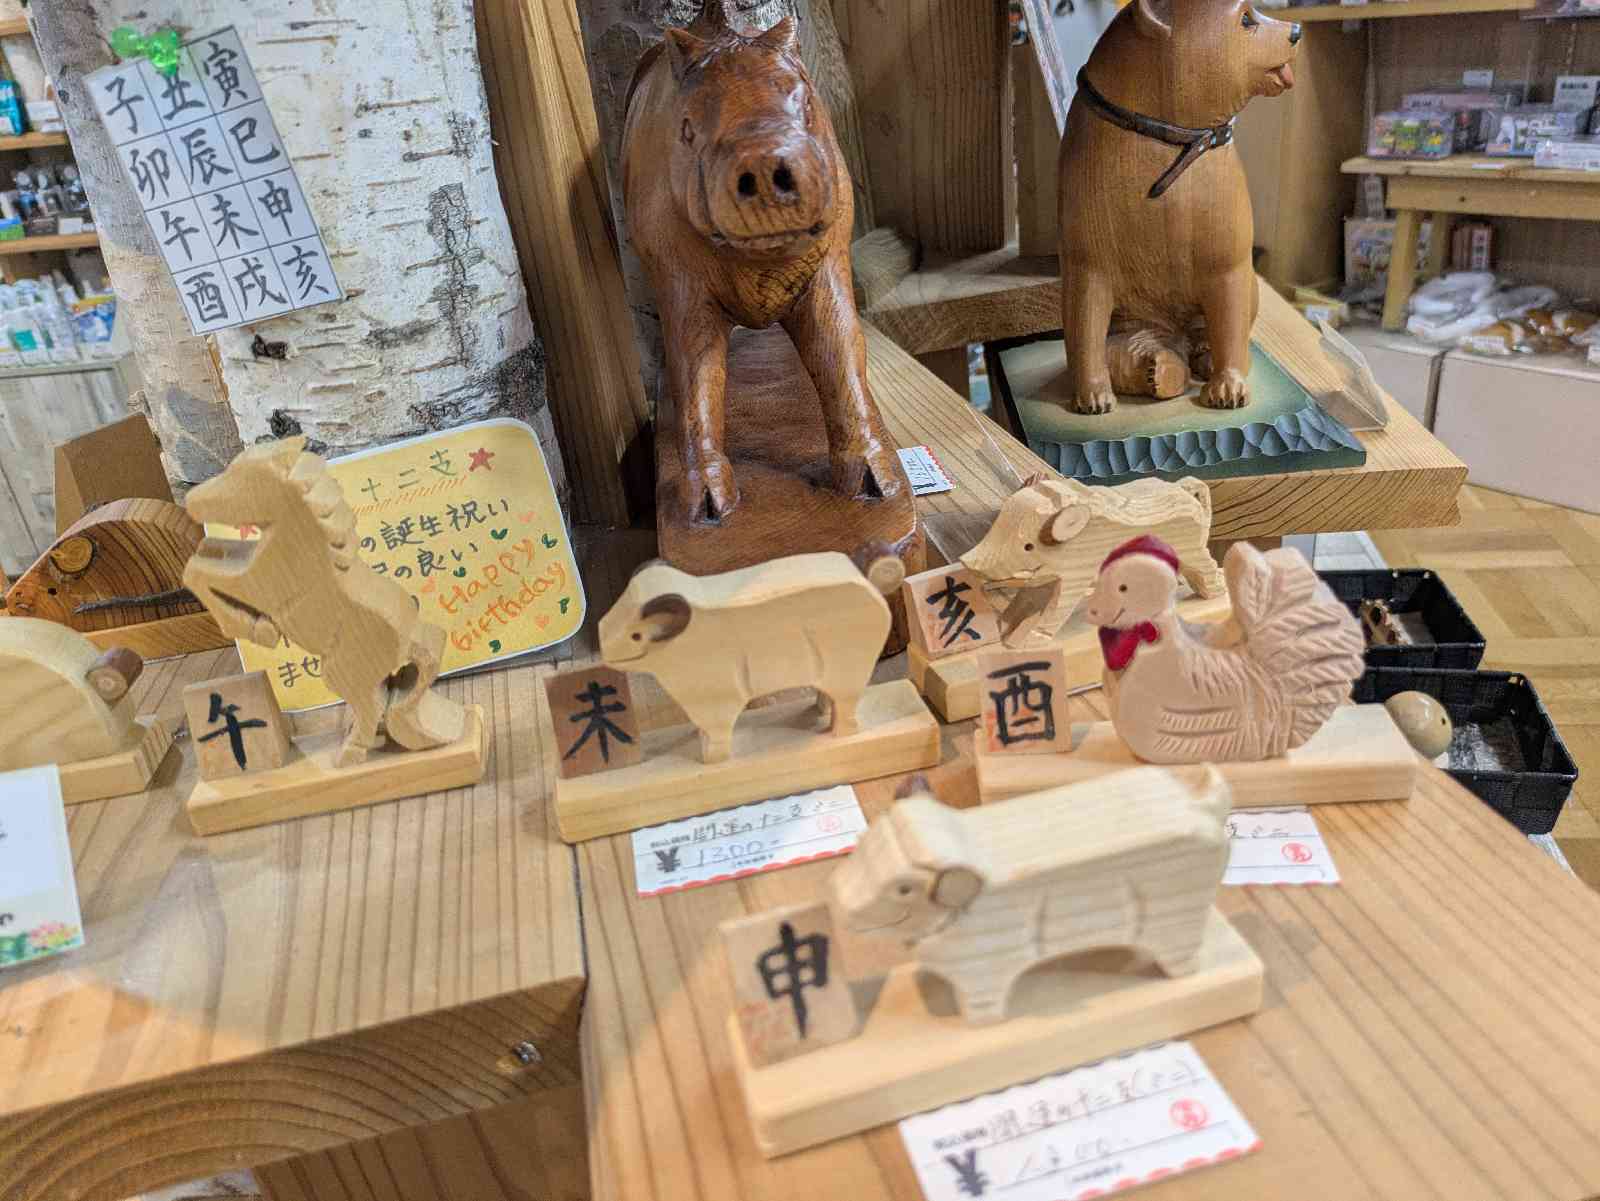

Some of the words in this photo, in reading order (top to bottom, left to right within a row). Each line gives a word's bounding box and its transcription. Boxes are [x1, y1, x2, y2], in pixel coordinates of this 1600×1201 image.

[105, 77, 144, 134] 子
[161, 70, 205, 120] 丑
[203, 41, 248, 108] 寅
[130, 148, 170, 200] 卯
[181, 128, 233, 185] 辰
[160, 210, 199, 261] 午
[211, 194, 258, 249] 未
[258, 179, 293, 236] 申
[183, 271, 228, 323] 酉
[283, 245, 330, 300] 亥
[438, 539, 536, 615] Happy
[927, 575, 981, 649] 亥
[197, 691, 268, 771] 午
[562, 682, 636, 765] 未
[986, 661, 1056, 747] 酉
[655, 846, 681, 873] ¥
[756, 921, 829, 1040] 申
[945, 1149, 988, 1197] ¥
